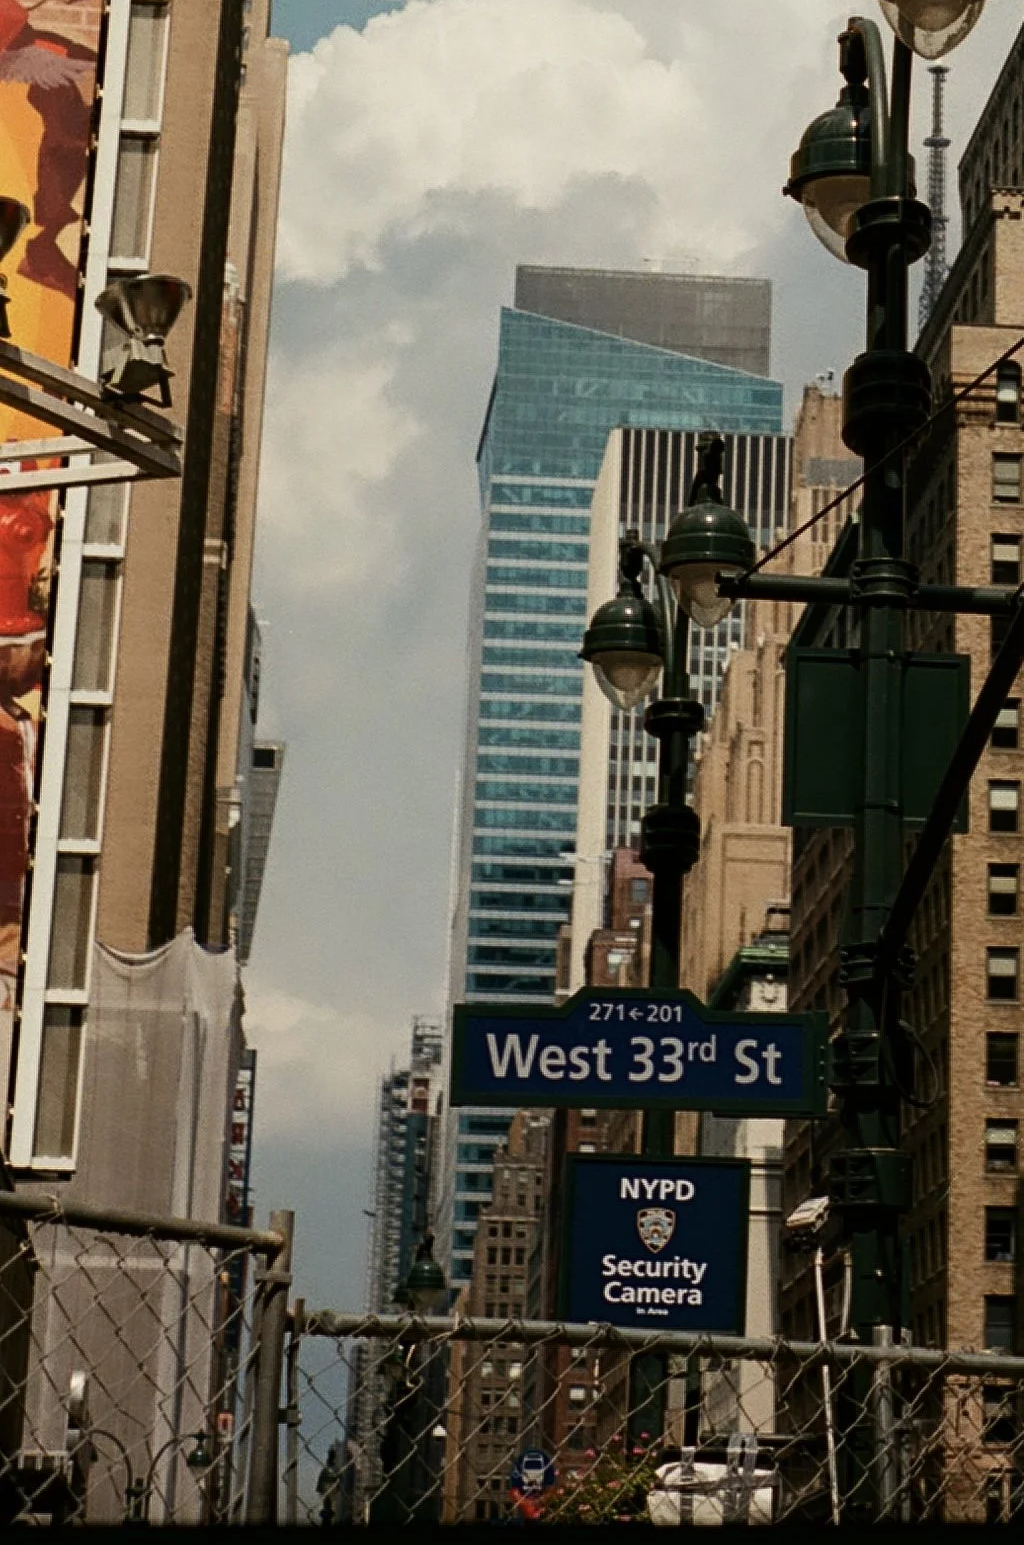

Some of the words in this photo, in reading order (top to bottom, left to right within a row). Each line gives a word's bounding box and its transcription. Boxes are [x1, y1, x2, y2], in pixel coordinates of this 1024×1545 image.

[589, 1002, 624, 1021] 271
[647, 1004, 682, 1023] 201
[485, 1032, 613, 1082] West
[627, 1034, 717, 1083] 33rd
[734, 1038, 783, 1086] St
[620, 1177, 695, 1202] NYPD
[602, 1254, 708, 1285] Security
[603, 1281, 703, 1306] Camera
